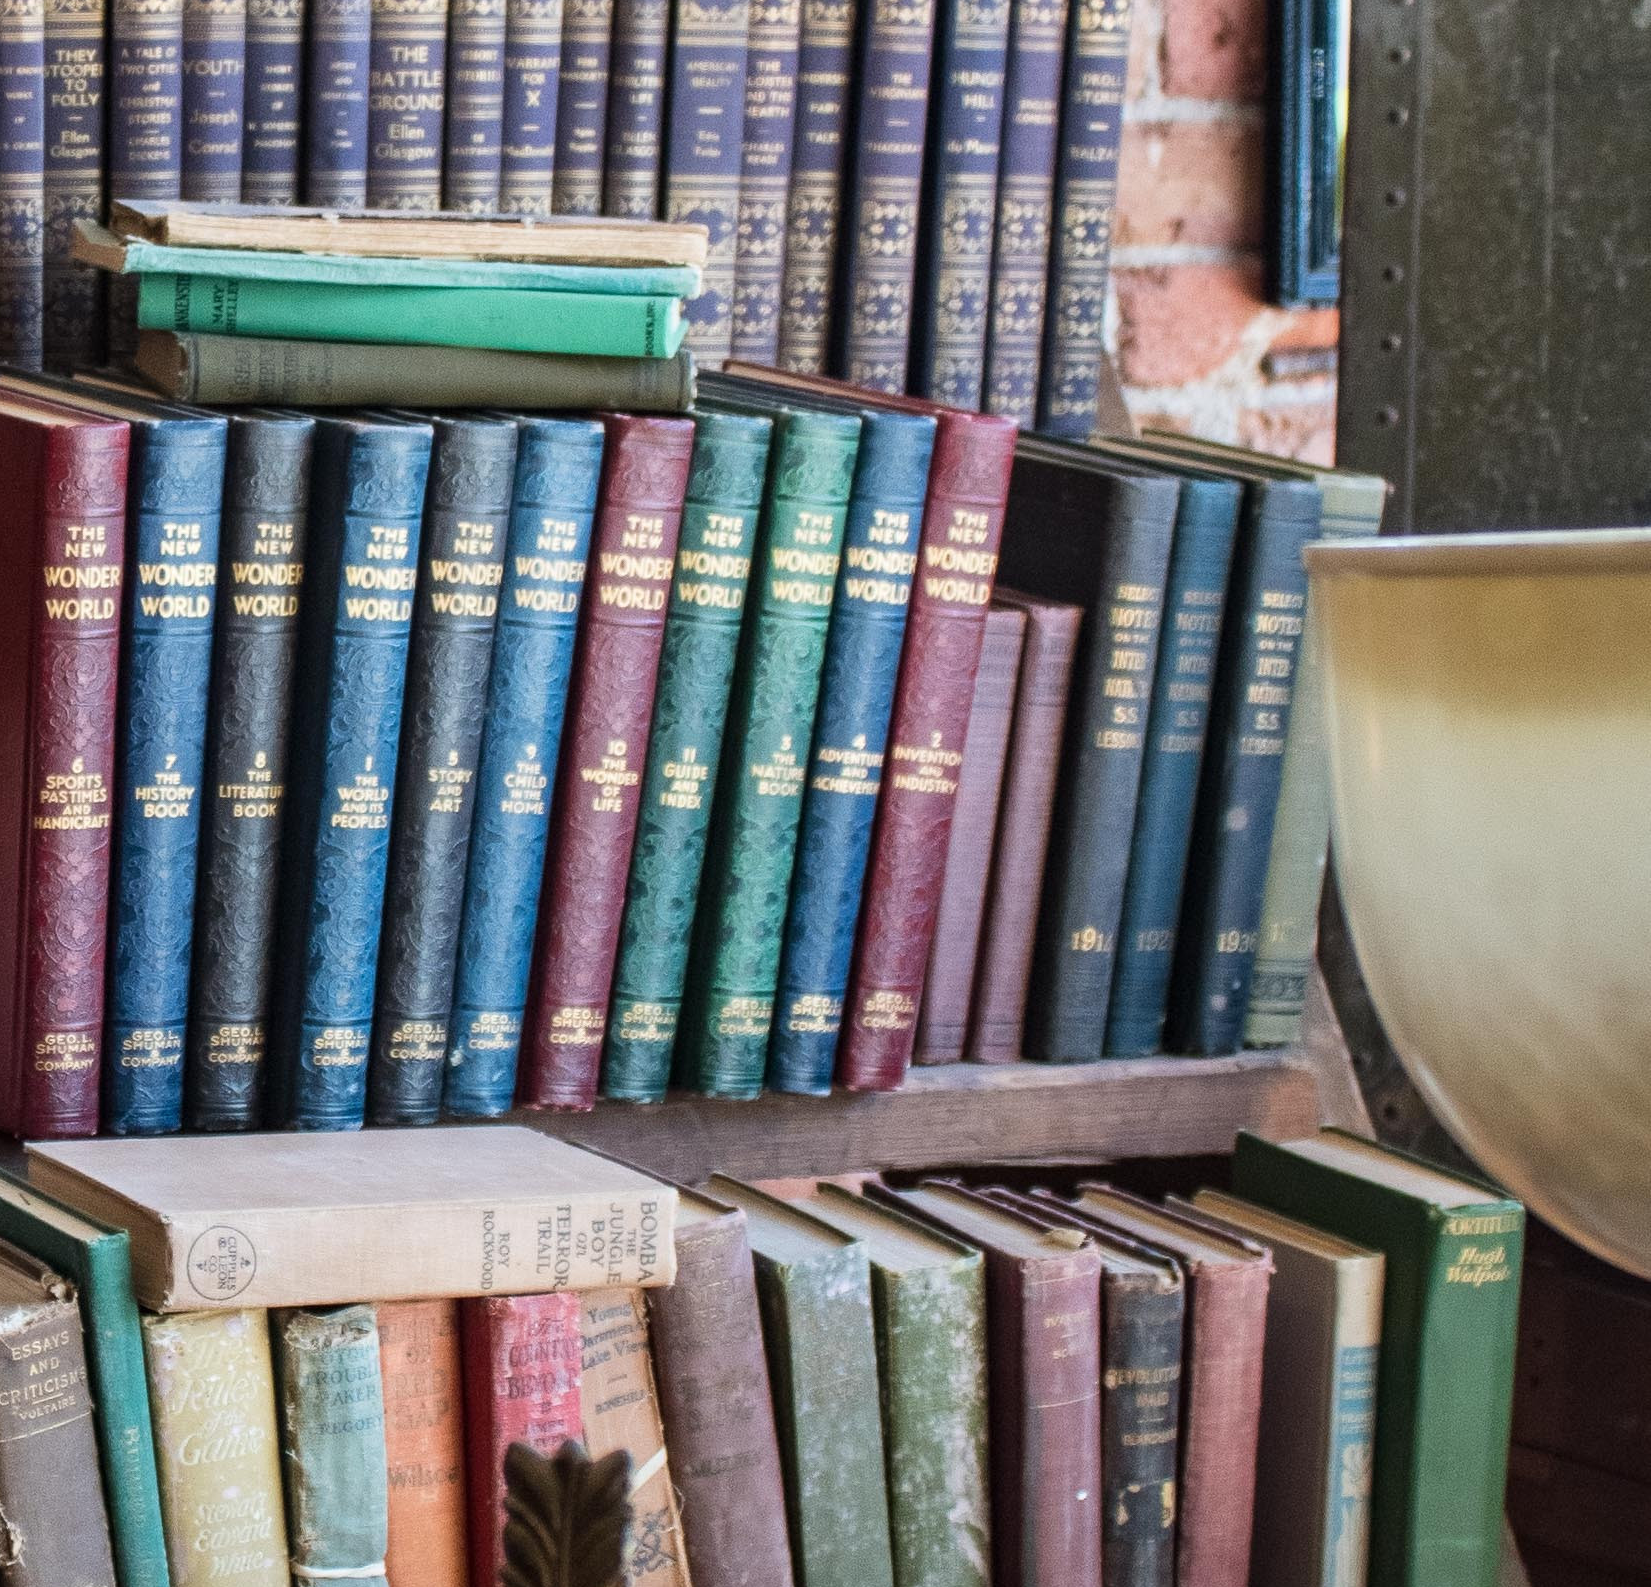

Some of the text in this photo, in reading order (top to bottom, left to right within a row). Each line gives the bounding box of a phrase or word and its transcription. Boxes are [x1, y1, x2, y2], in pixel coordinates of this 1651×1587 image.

[56, 49, 96, 61] THEY
[390, 46, 428, 63] THE
[65, 79, 86, 91] TO
[371, 70, 442, 88] BATTLE
[52, 93, 100, 106] FOLLY
[370, 94, 443, 111] GROUND
[68, 527, 105, 541] THE
[163, 523, 201, 538] THE
[257, 524, 293, 539] THE
[371, 526, 408, 543] THE
[458, 522, 494, 538] THE
[541, 519, 576, 536] THE
[537, 535, 576, 552] NEW
[622, 532, 663, 549] NEW
[702, 530, 742, 548] NEW
[794, 528, 833, 545] NEW
[65, 543, 106, 557] NEW
[161, 540, 201, 555] NEW
[254, 540, 293, 555] NEW
[367, 544, 408, 560] NEW
[454, 539, 494, 555] NEW
[233, 562, 304, 586] WONDER
[431, 560, 503, 586] WONDER
[514, 557, 586, 582] WONDER
[600, 552, 674, 580] WONDER
[44, 566, 120, 588] WONDER
[139, 564, 216, 586] WONDER
[431, 593, 497, 616] WORLD
[514, 588, 577, 612] WORLD
[600, 583, 664, 610] WORLD
[46, 598, 115, 620] WORLD
[141, 596, 210, 618] WORLD
[234, 595, 299, 616] WORLD
[346, 597, 411, 621] WORLD
[609, 740, 627, 756] 10
[931, 732, 942, 748] 2
[72, 758, 84, 773] 6
[164, 754, 176, 769] 7
[255, 751, 267, 768] 8
[428, 770, 472, 783] STORY
[664, 762, 708, 780] GUIDE
[46, 775, 102, 789] SPORTS
[504, 774, 546, 789] CHILD
[893, 775, 958, 794] INDUSTRY
[40, 789, 107, 803] PASTIMES
[135, 787, 195, 801] HISTORY
[602, 786, 620, 796] OF
[341, 803, 367, 813] AND
[430, 800, 462, 813] ART
[502, 800, 545, 814] HOME
[593, 798, 622, 812] LIFE
[660, 793, 702, 809] INDEX
[62, 805, 91, 815] AND
[144, 804, 190, 818] BOOK
[233, 804, 277, 817] BOOK
[34, 814, 109, 830] HANDICRAFT
[331, 815, 387, 829] PEOPLES
[36, 1043, 95, 1054] SHUMAN
[35, 1059, 94, 1071] COMPANY
[121, 1055, 180, 1067] COMPANY
[481, 1211, 494, 1290] ROCKWOOD
[498, 1233, 510, 1268] ROY
[537, 1216, 551, 1274] TRAIL
[553, 1205, 571, 1289] TERROR
[591, 1221, 606, 1267] BOY
[607, 1203, 624, 1284] JUNGLE
[637, 1202, 658, 1282] BOMBA
[228, 1237, 236, 1290] CUPPLES
[218, 1256, 227, 1289] LEON
[12, 1331, 69, 1360] ESSAYS
[29, 1356, 60, 1376] AND
[19, 1396, 76, 1420] VOLTAIRE
